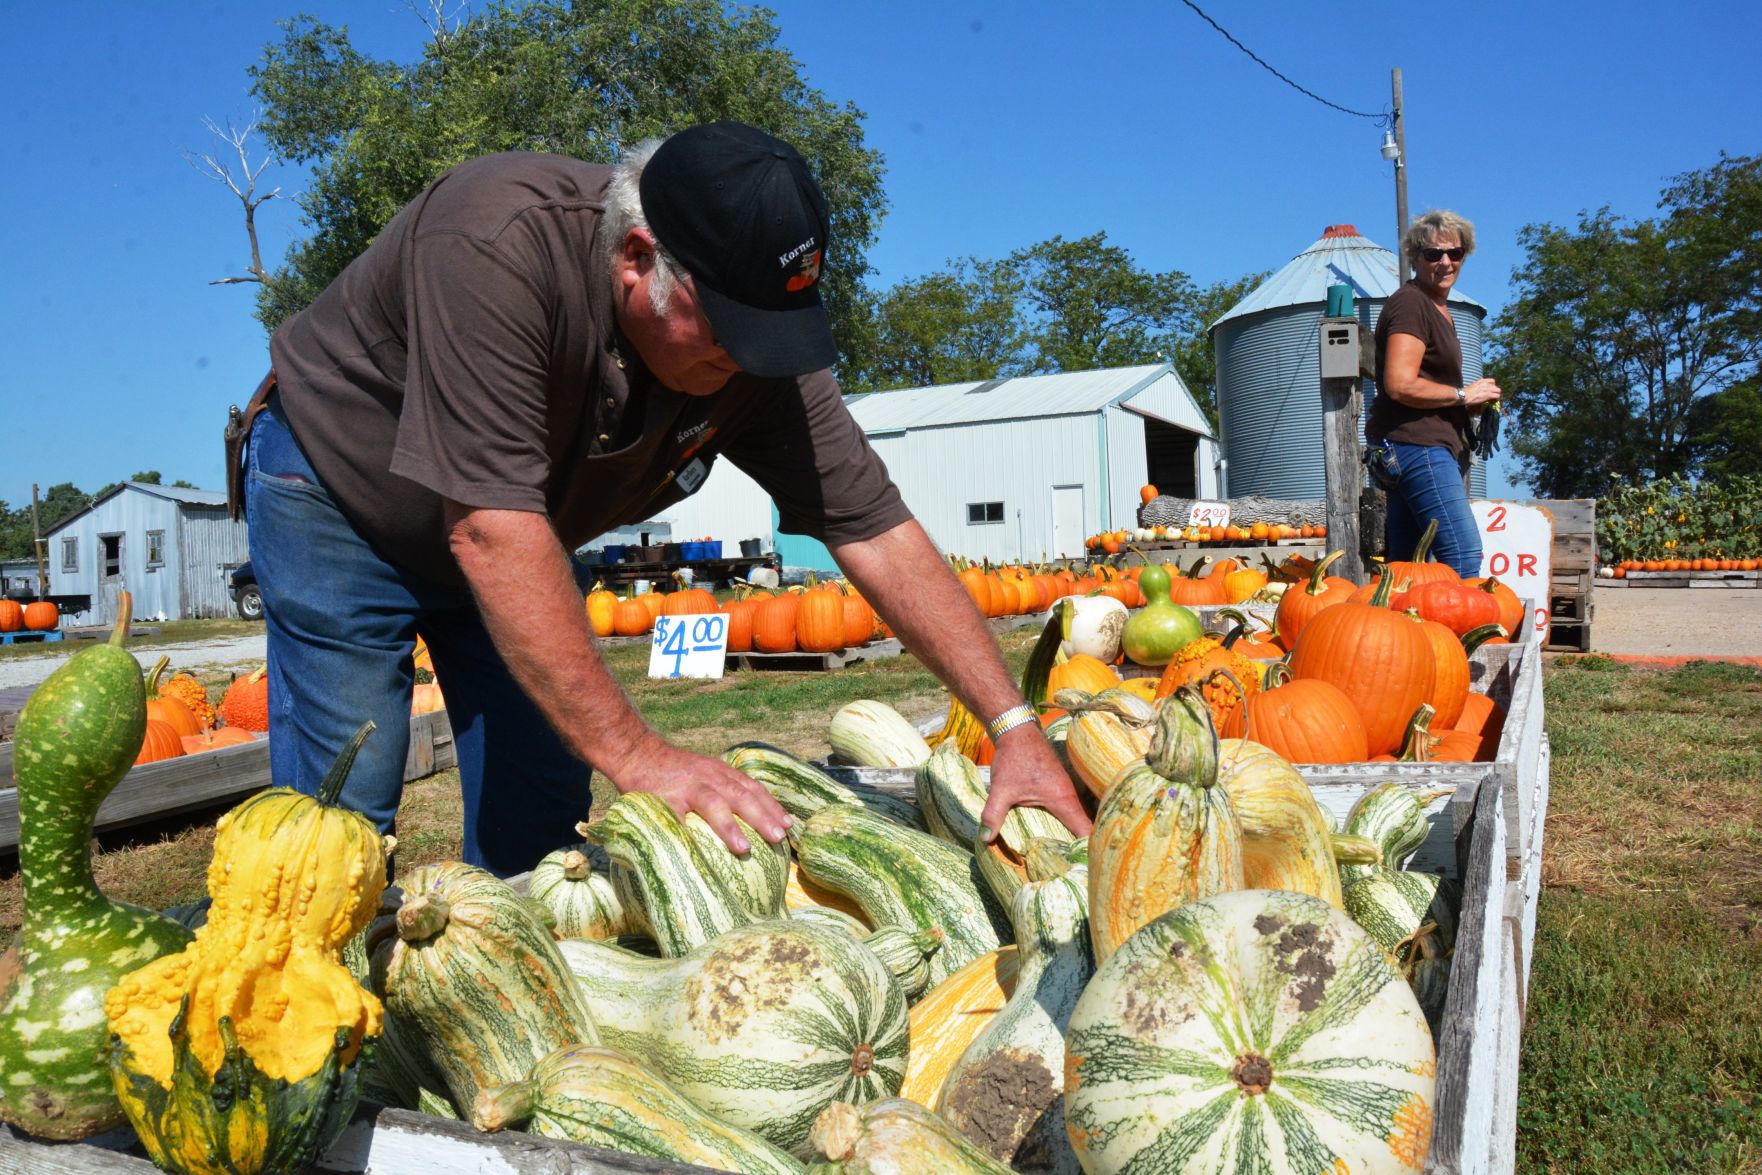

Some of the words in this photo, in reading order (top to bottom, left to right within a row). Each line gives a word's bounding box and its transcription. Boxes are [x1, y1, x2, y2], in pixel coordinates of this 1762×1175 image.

[779, 237, 814, 268] Korner
[1486, 506, 1507, 532] 2
[1481, 552, 1537, 577] OR
